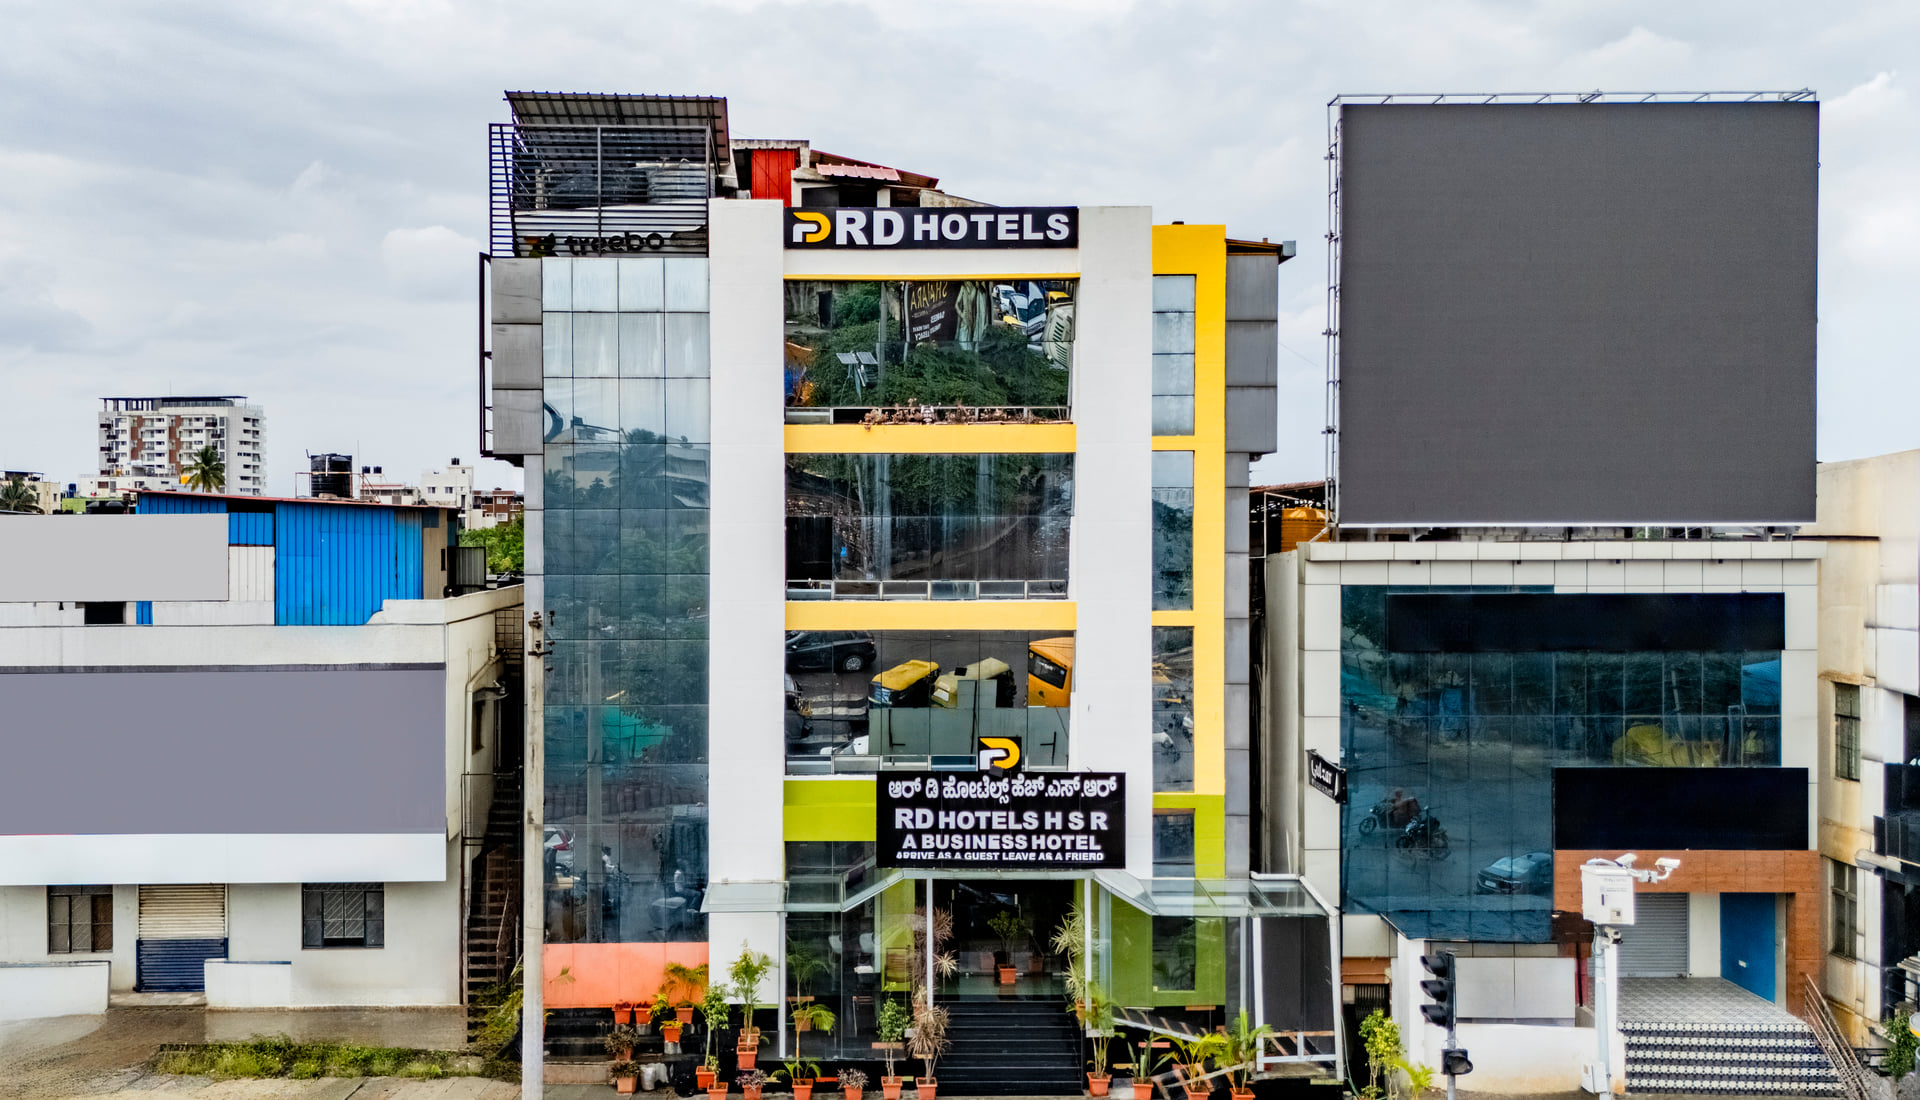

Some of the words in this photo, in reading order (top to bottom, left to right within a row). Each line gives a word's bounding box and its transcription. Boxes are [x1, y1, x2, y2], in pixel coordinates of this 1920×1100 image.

[835, 210, 905, 246] RD
[913, 214, 1070, 241] HOTELS
[565, 231, 664, 255] treebo
[888, 777, 922, 798] ಆರ್
[925, 778, 939, 798] ಡಿ
[895, 808, 934, 829] RD
[938, 811, 1039, 830] HOTELS
[902, 834, 917, 850] A
[921, 834, 1028, 850] BUSINESS
[1031, 835, 1102, 851] HOTEL
[937, 852, 952, 861] AS
[954, 852, 962, 861] A
[964, 852, 1000, 861] GUEST
[1002, 852, 1036, 861] LEAVE
[1038, 852, 1053, 861] AS
[1054, 852, 1063, 861] A
